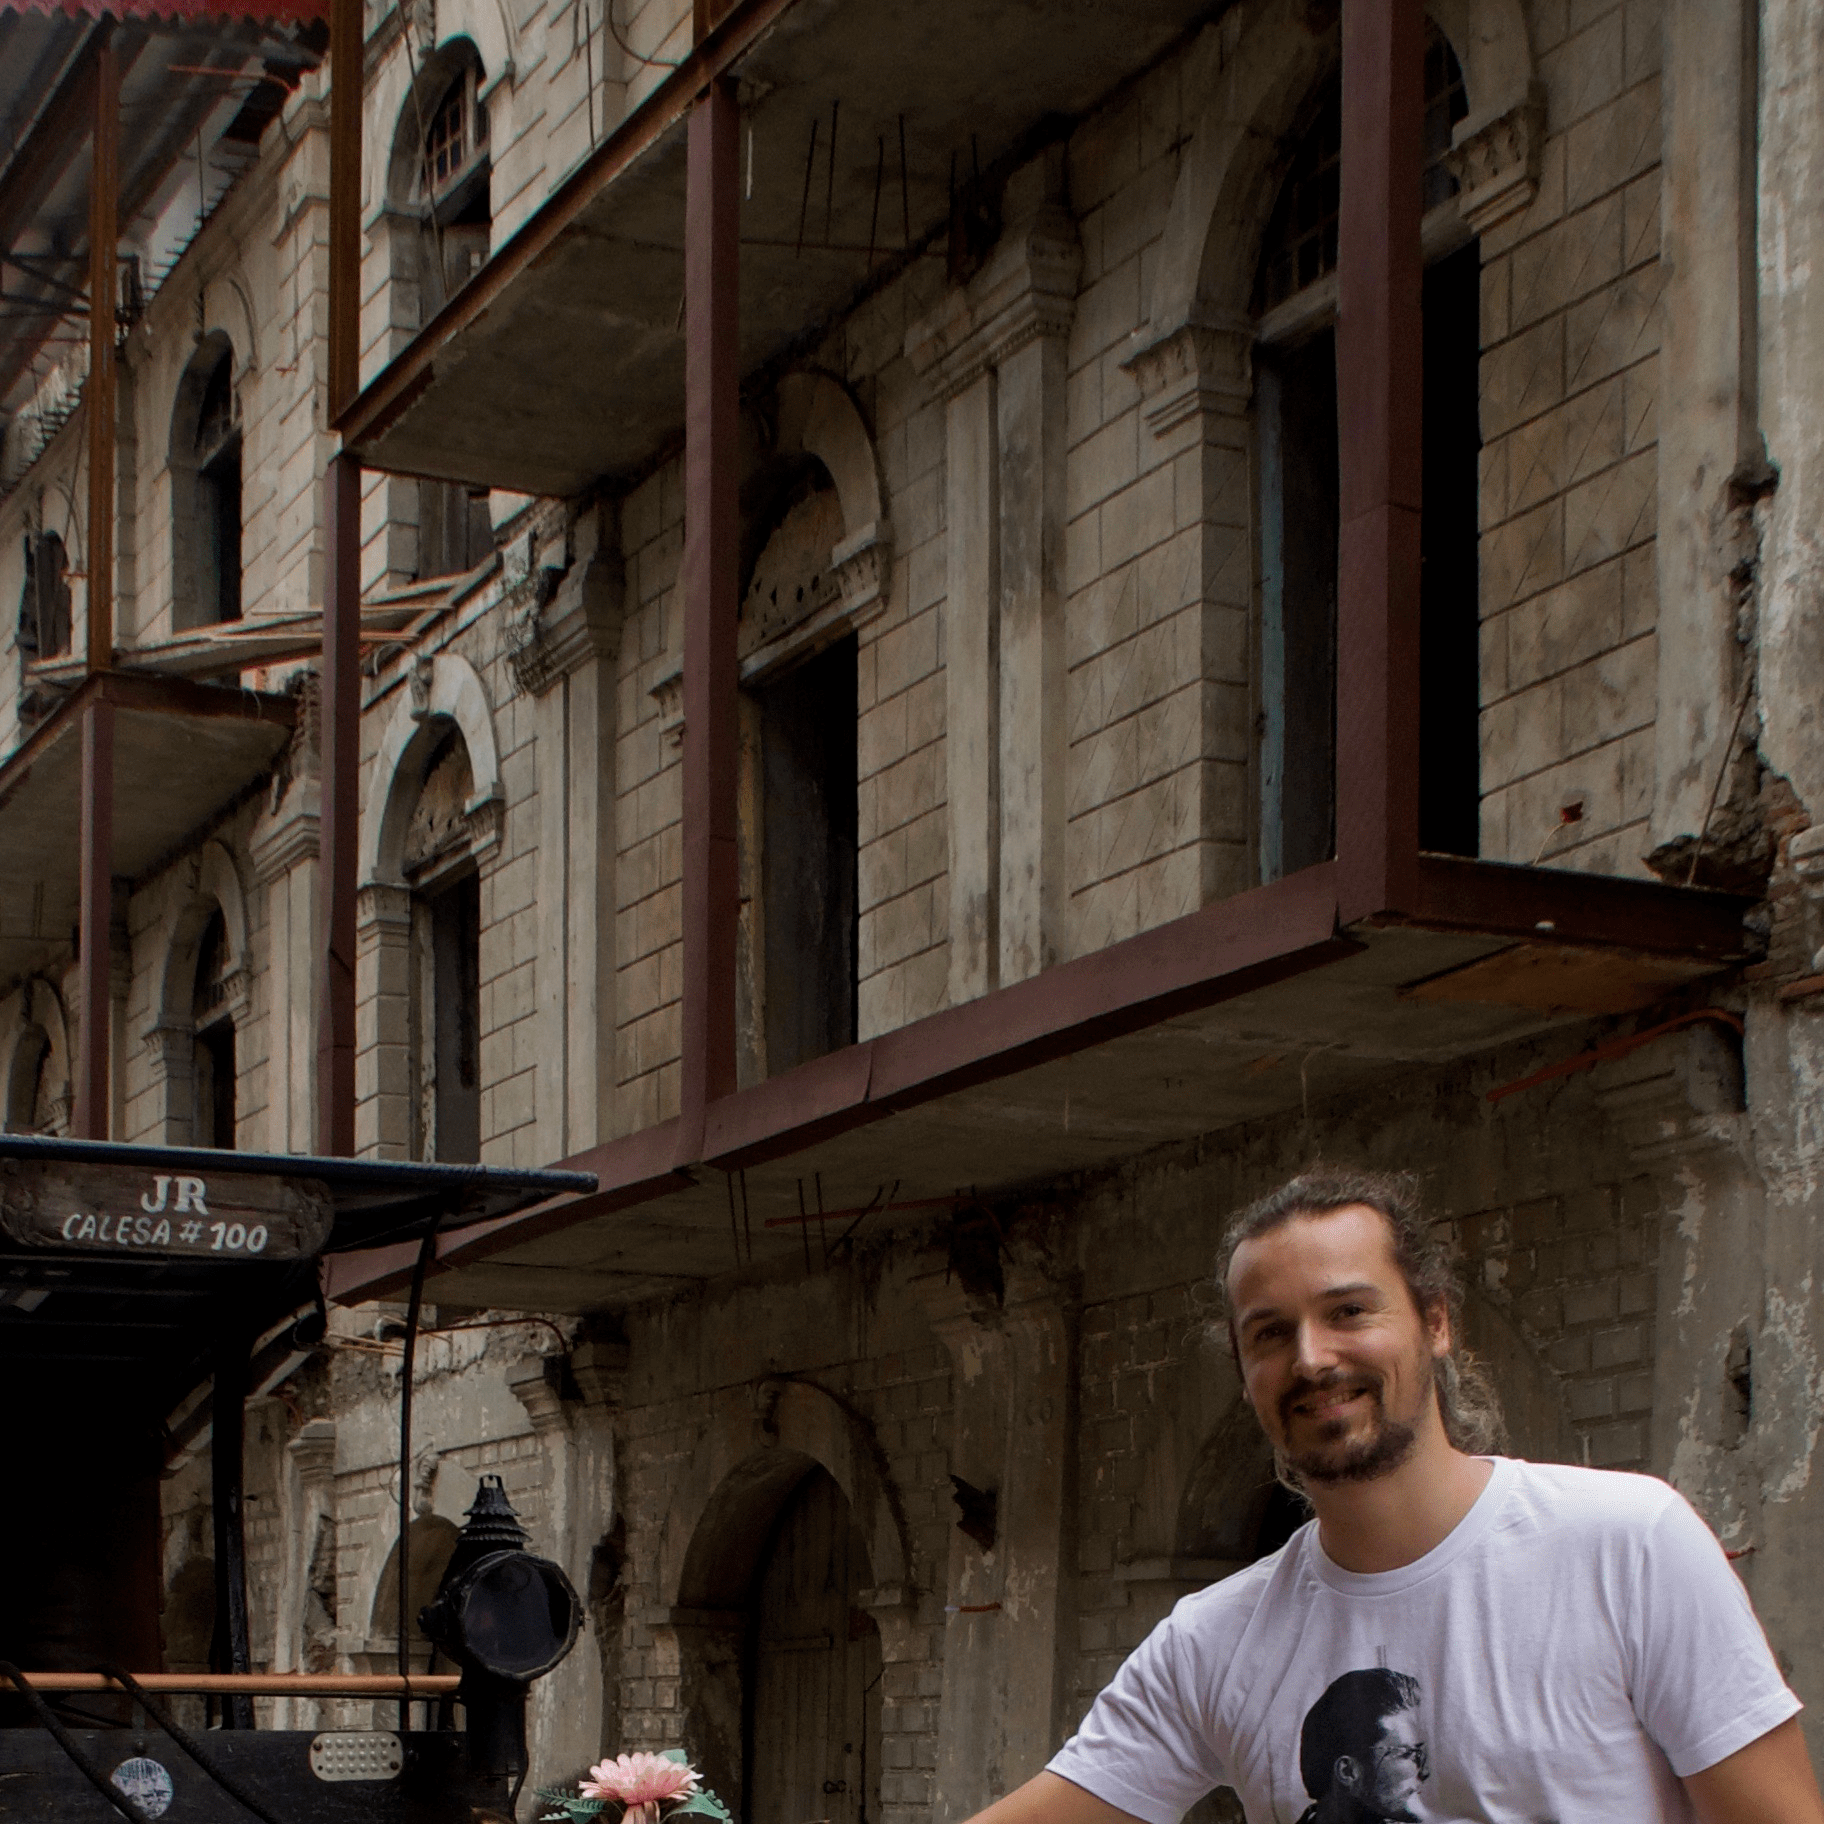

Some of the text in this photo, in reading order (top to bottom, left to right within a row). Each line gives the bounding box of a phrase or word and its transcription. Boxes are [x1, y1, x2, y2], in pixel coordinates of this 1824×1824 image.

[140, 1175, 210, 1215] JR
[61, 1213, 171, 1246] CALESA
[210, 1221, 268, 1252] 100
